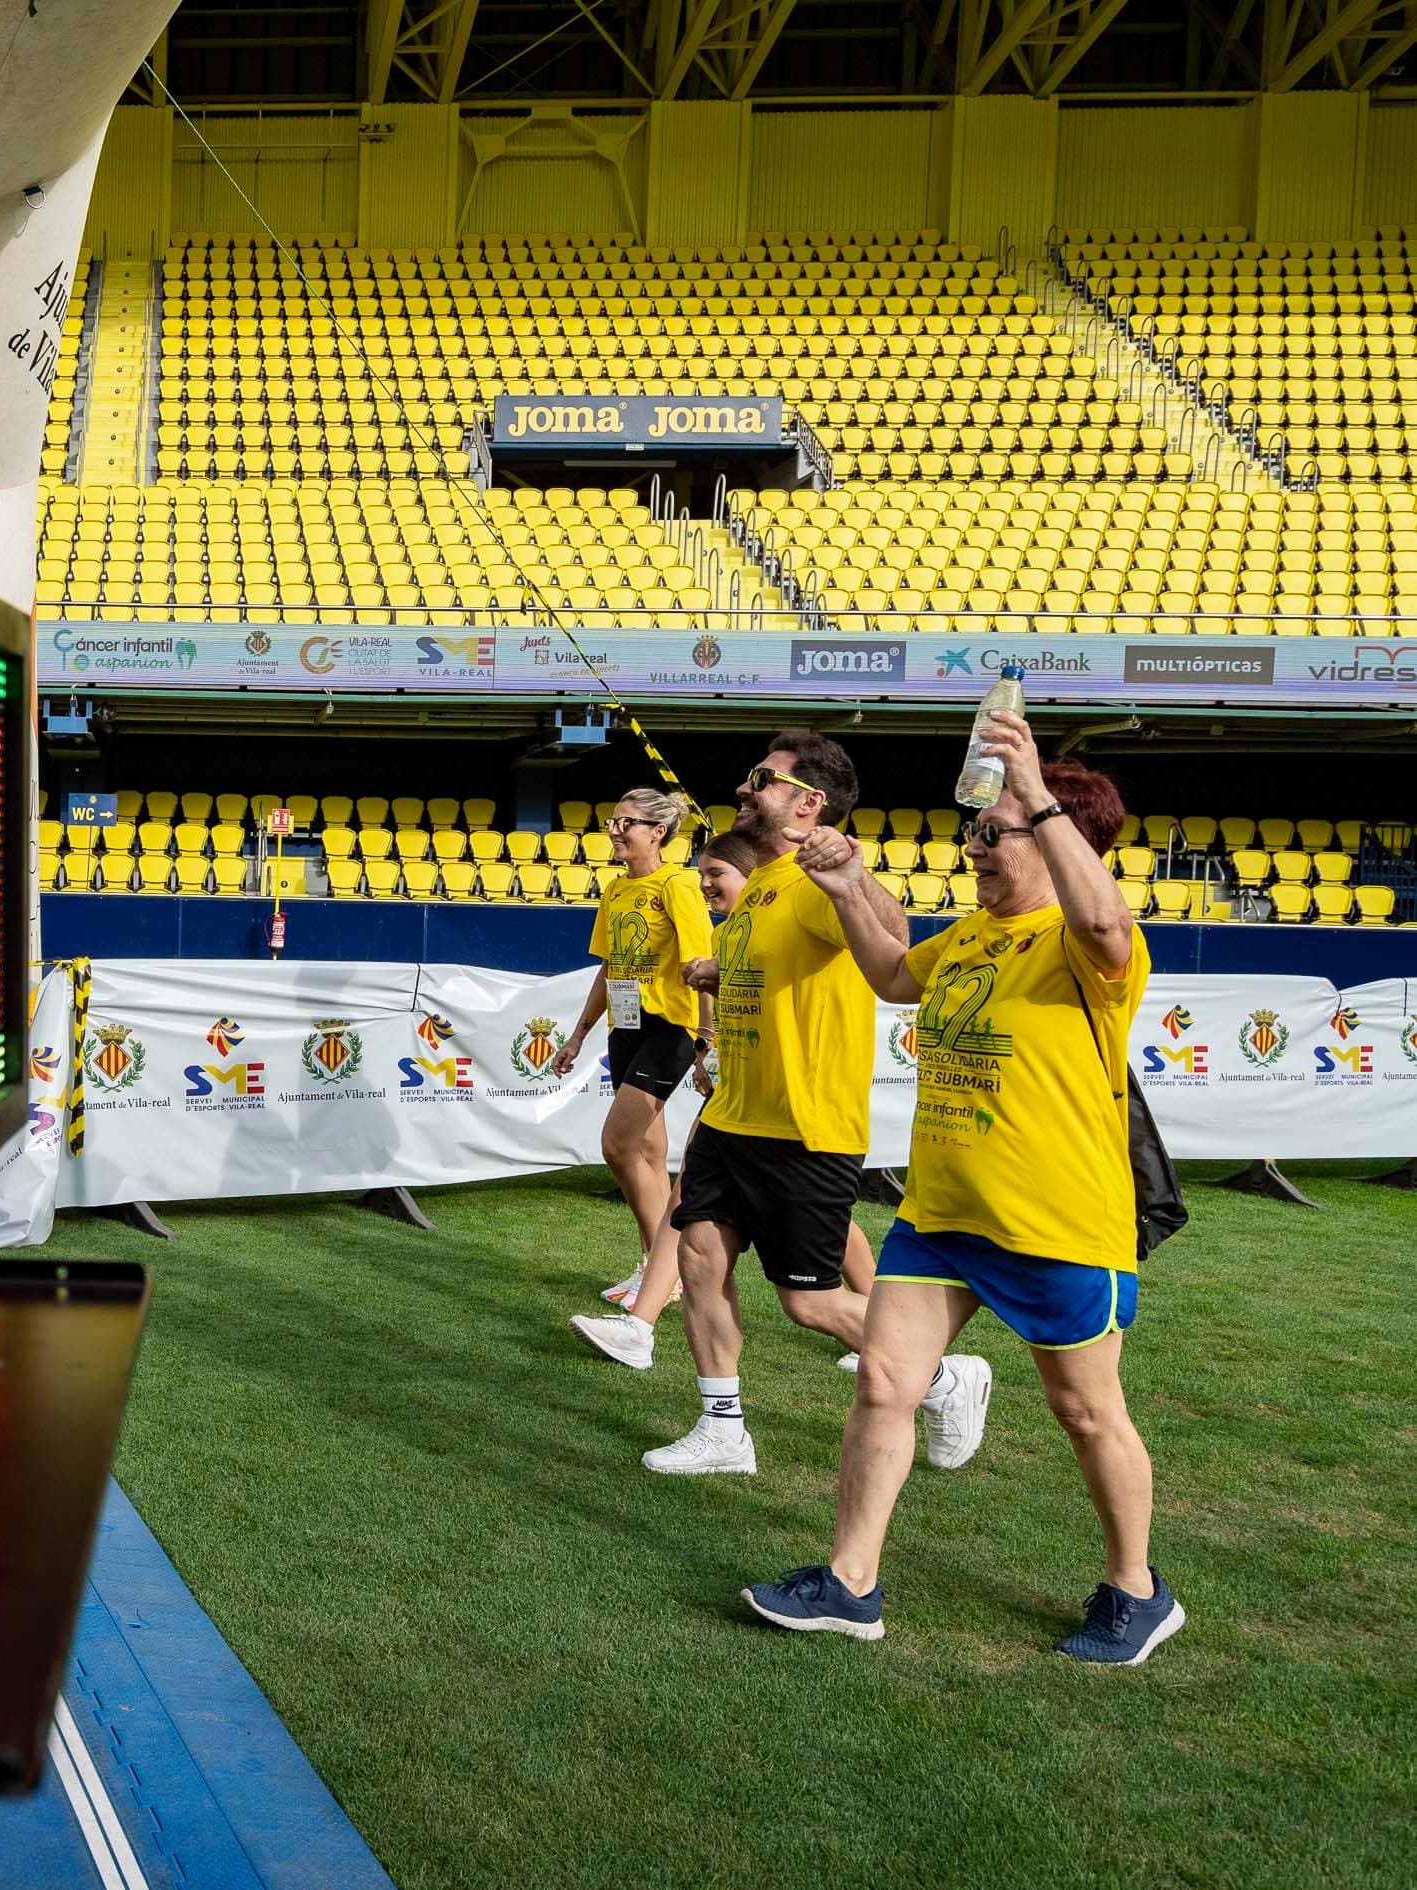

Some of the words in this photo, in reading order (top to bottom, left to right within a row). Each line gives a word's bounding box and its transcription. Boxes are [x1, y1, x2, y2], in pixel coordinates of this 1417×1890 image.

[7, 328, 31, 359] de
[54, 629, 119, 653] Cáncer
[123, 637, 173, 656] infantil
[95, 655, 173, 673] aspanion
[980, 649, 1092, 671] CaixaBank
[419, 668, 492, 677] VILA-REAL
[650, 672, 733, 685] VILLARREAL
[738, 674, 763, 685] C.F.
[72, 807, 95, 821] WC
[1142, 1045, 1209, 1073] SME
[1313, 1045, 1374, 1073] SME
[184, 1063, 265, 1096] SME
[397, 1057, 474, 1088] SME
[1218, 1072, 1264, 1083] Ajuntament
[1272, 1072, 1305, 1081] Vila-real
[1382, 1072, 1417, 1084] Ajuntame
[873, 1075, 916, 1087] juntament
[934, 1071, 1000, 1093] SUBMARÍ
[222, 1095, 266, 1103] MUNICIPAL
[278, 1091, 336, 1105] Ajuntament
[336, 1092, 344, 1100] de
[345, 1087, 387, 1099] Vila-real
[485, 1086, 540, 1099] Ajuntament
[128, 1096, 172, 1108] Vila-real
[229, 1103, 266, 1111] VILA-REAL
[933, 1100, 974, 1119] infantil
[715, 1399, 734, 1407] NIKE
